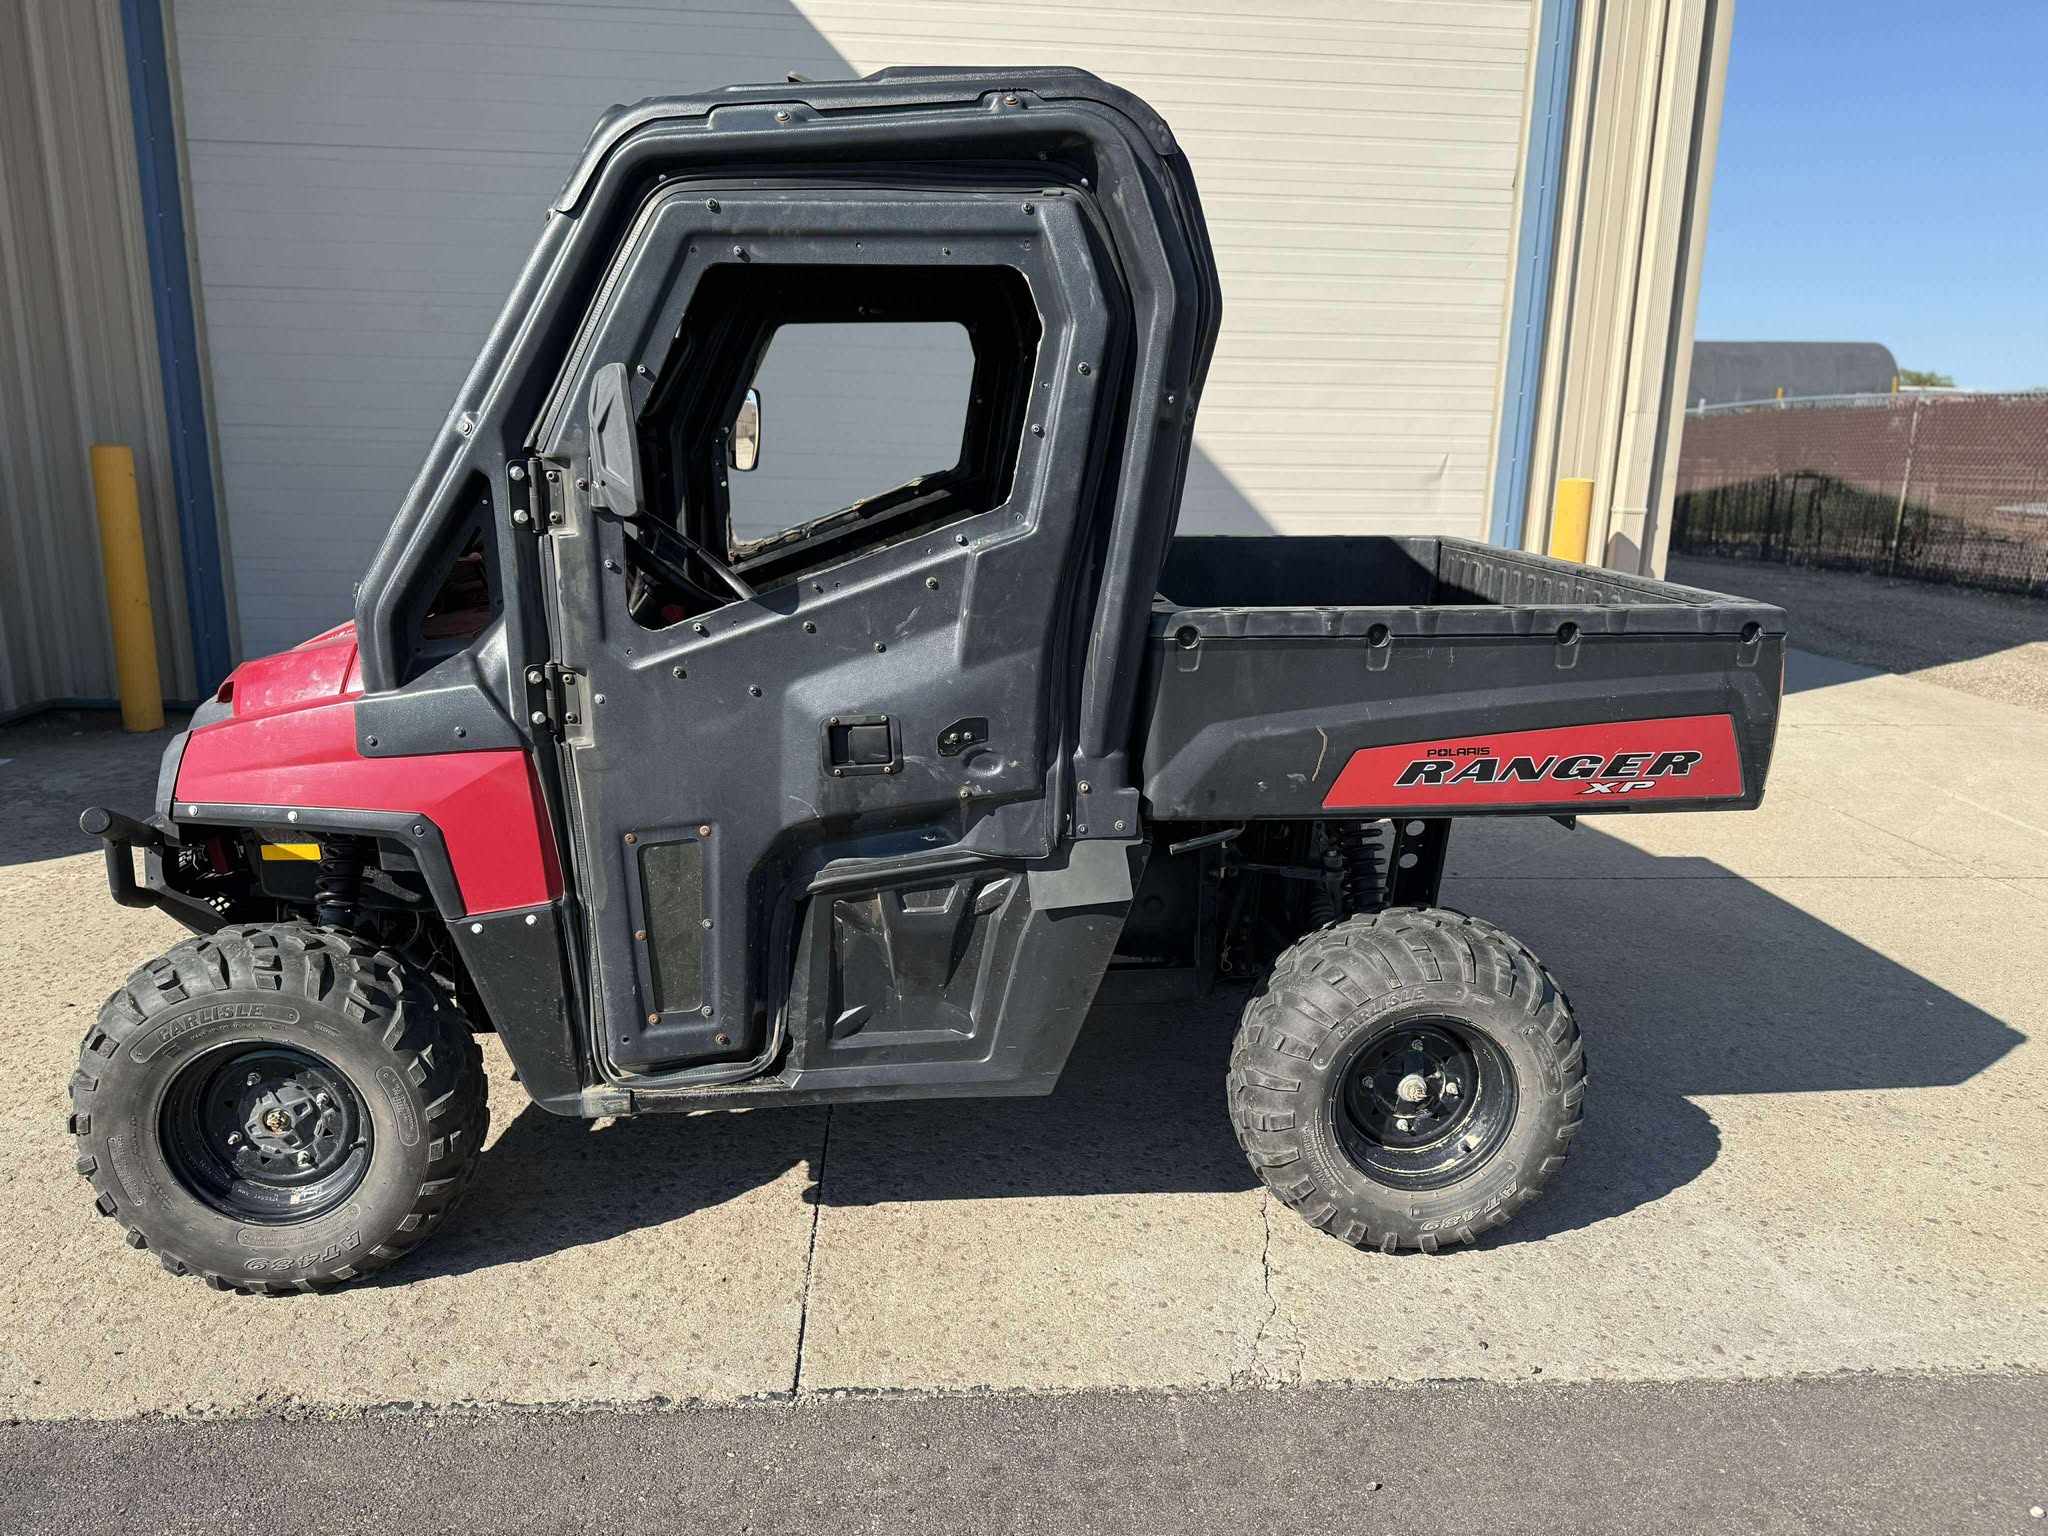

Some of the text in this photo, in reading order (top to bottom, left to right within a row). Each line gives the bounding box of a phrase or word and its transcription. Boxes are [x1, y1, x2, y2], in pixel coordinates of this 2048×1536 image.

[1393, 750, 1703, 787] RANGER
[1427, 747, 1490, 757] POLARIS
[1576, 780, 1656, 795] XP
[156, 1003, 265, 1043] CARLISLE
[1338, 987, 1426, 1041] CARLISLE
[1421, 1178, 1519, 1232] AT489
[244, 1230, 361, 1272] AT489
